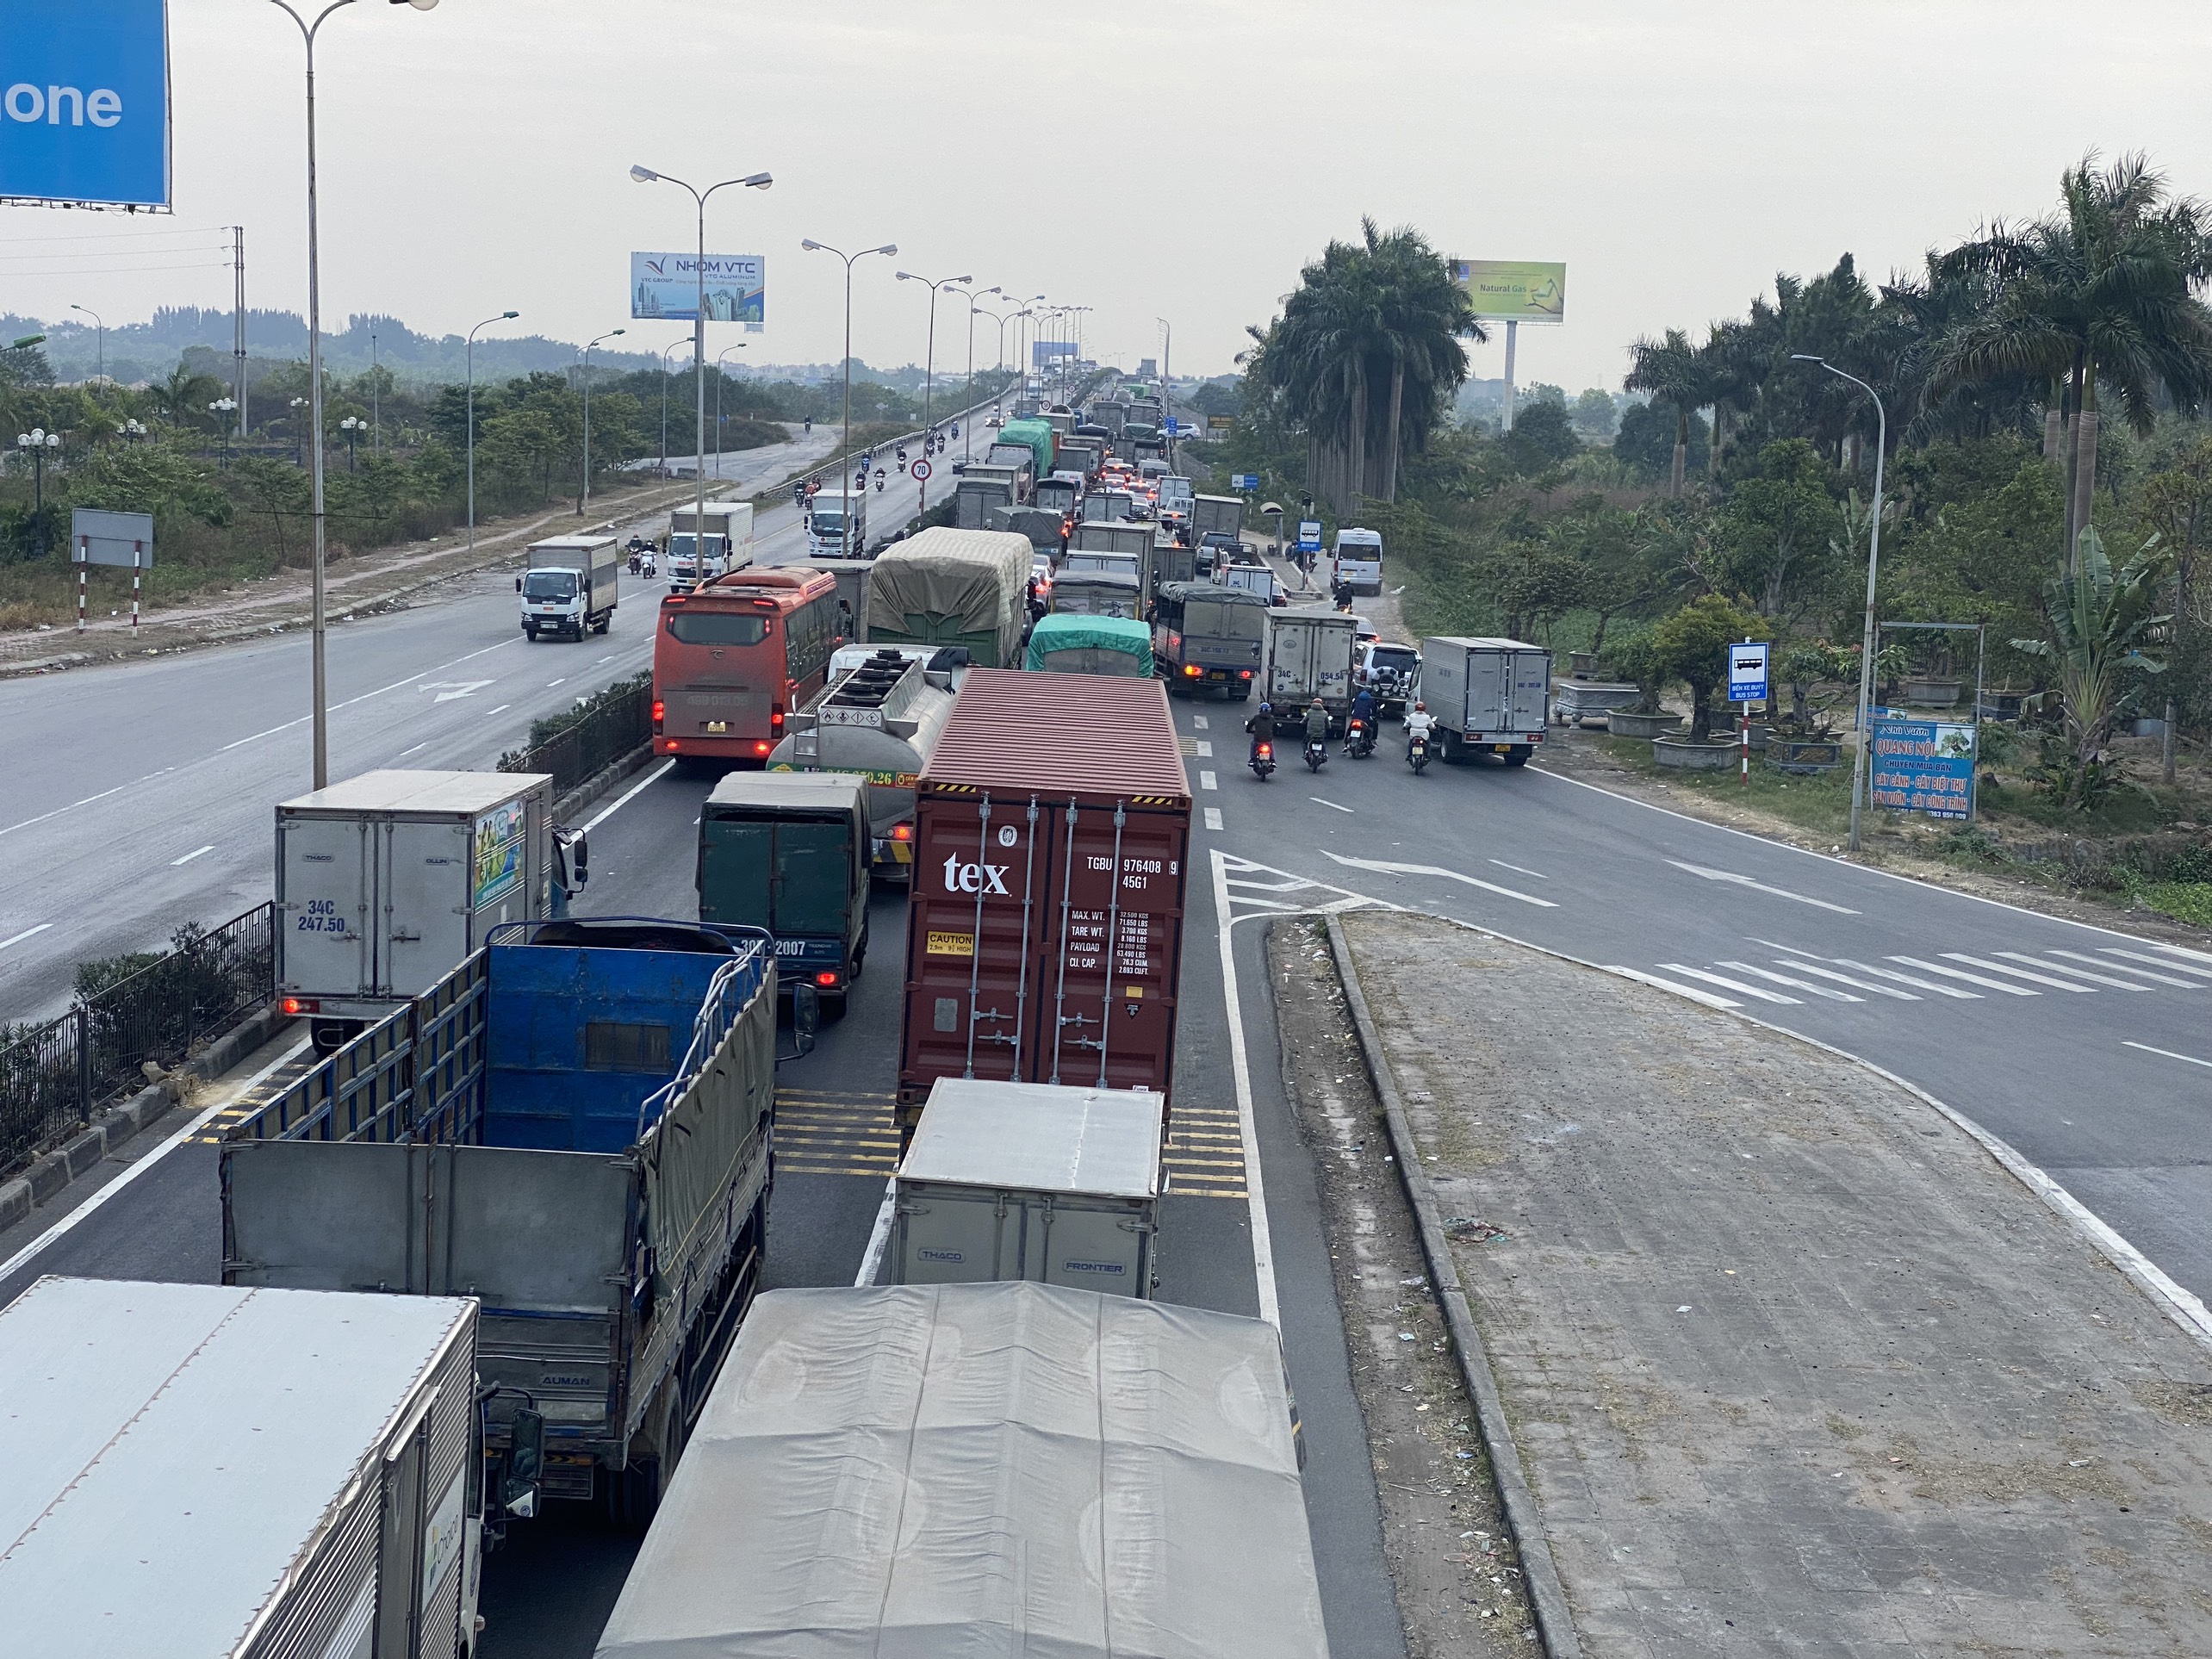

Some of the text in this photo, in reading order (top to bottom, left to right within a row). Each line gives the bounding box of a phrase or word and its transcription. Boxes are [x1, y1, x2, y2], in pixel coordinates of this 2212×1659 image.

[0, 83, 122, 128] one
[724, 262, 755, 274] VTC
[1480, 284, 1510, 293] Natural
[917, 465, 926, 475] 70
[1320, 672, 1344, 680] 054.54
[1875, 737, 1936, 761] QUANG NỘI
[1916, 761, 1933, 771] MUA
[1935, 761, 1952, 772] BÁN
[1875, 772, 1889, 786] CÂY
[1890, 771, 1910, 787] CẢNH
[1915, 774, 1931, 789] CÂY
[1932, 774, 1949, 793] BIỆT
[1873, 788, 1886, 805] SÂN
[1911, 792, 1926, 807] CÂY
[1926, 792, 1946, 810] CÔNG
[1947, 794, 1968, 811] TRÌNH
[1086, 856, 1178, 875] TGBU 976408 9
[1122, 875, 1147, 890] 45G1
[308, 900, 334, 915] 34C
[1072, 910, 1105, 921] MAX. WT.
[297, 916, 345, 932] 247.50
[1138, 919, 1148, 928] LBS
[1072, 926, 1104, 937] TARE WT.
[929, 934, 972, 945] CAUTION
[775, 940, 805, 956] 2007
[1070, 941, 1100, 953] PAYLOAD
[1069, 957, 1097, 968] CU. CAP.
[923, 1250, 962, 1260] THACO
[1066, 1262, 1122, 1273] FRONTIER
[543, 1376, 590, 1385] AUMAN
